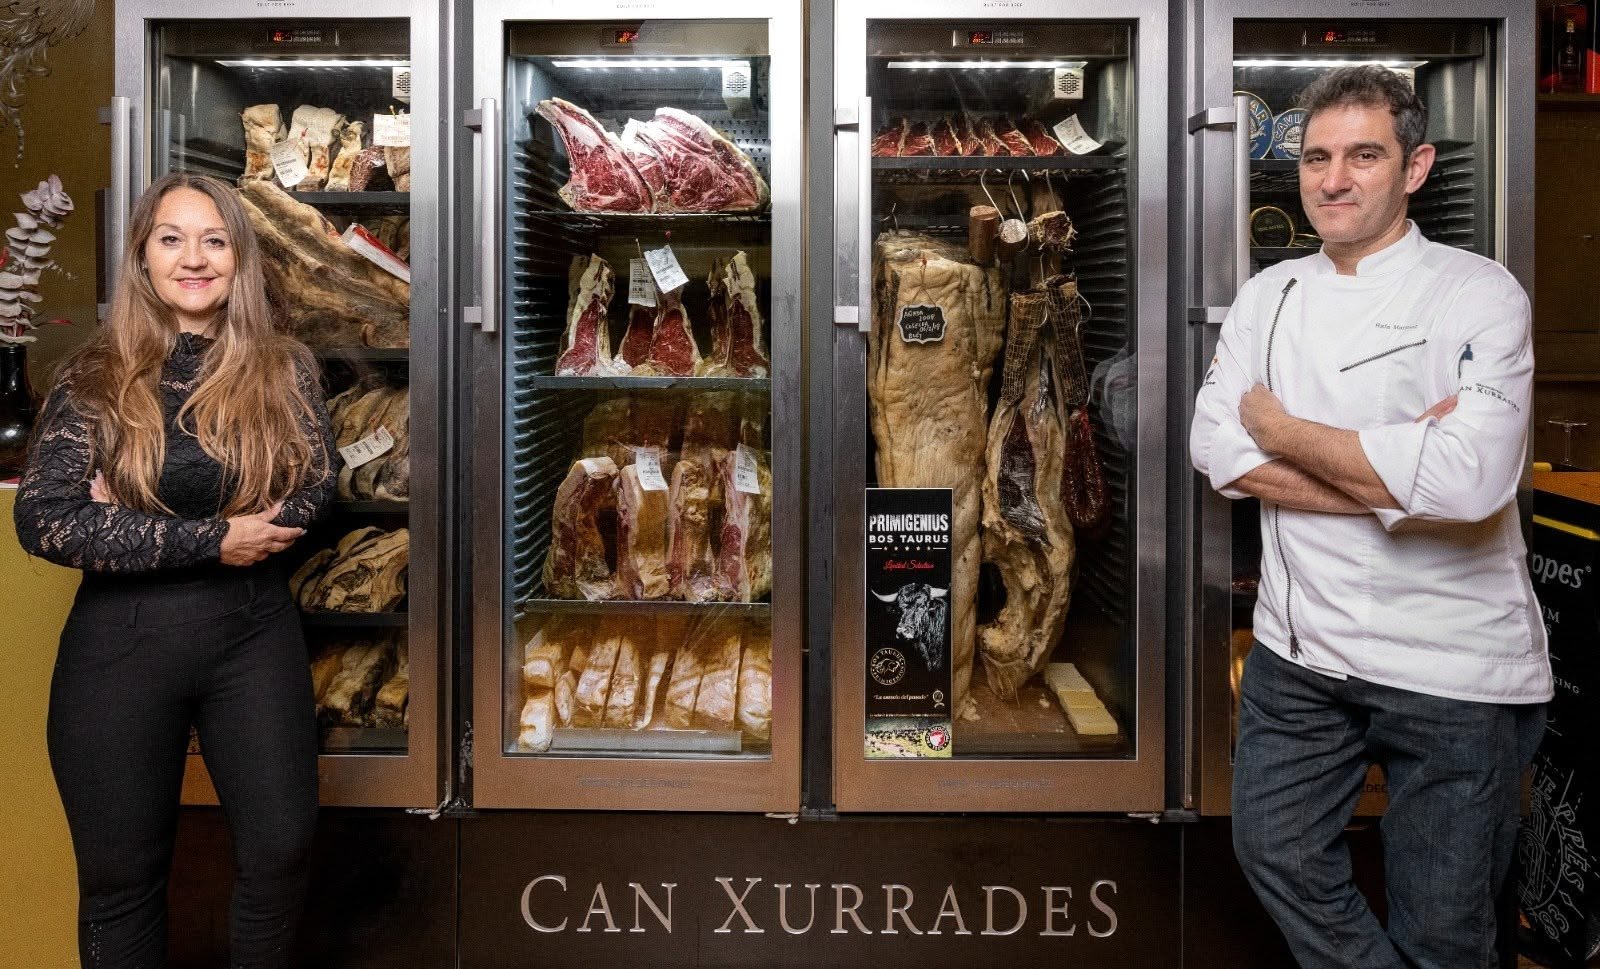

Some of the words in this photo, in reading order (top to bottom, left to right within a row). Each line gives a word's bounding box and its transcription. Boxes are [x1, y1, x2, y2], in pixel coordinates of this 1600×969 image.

[869, 513, 949, 532] PRIMIGENIUS
[869, 534, 894, 544] BOS
[900, 534, 949, 544] TAURUS
[520, 874, 678, 934] CAN
[714, 876, 1118, 938] XURRADES
